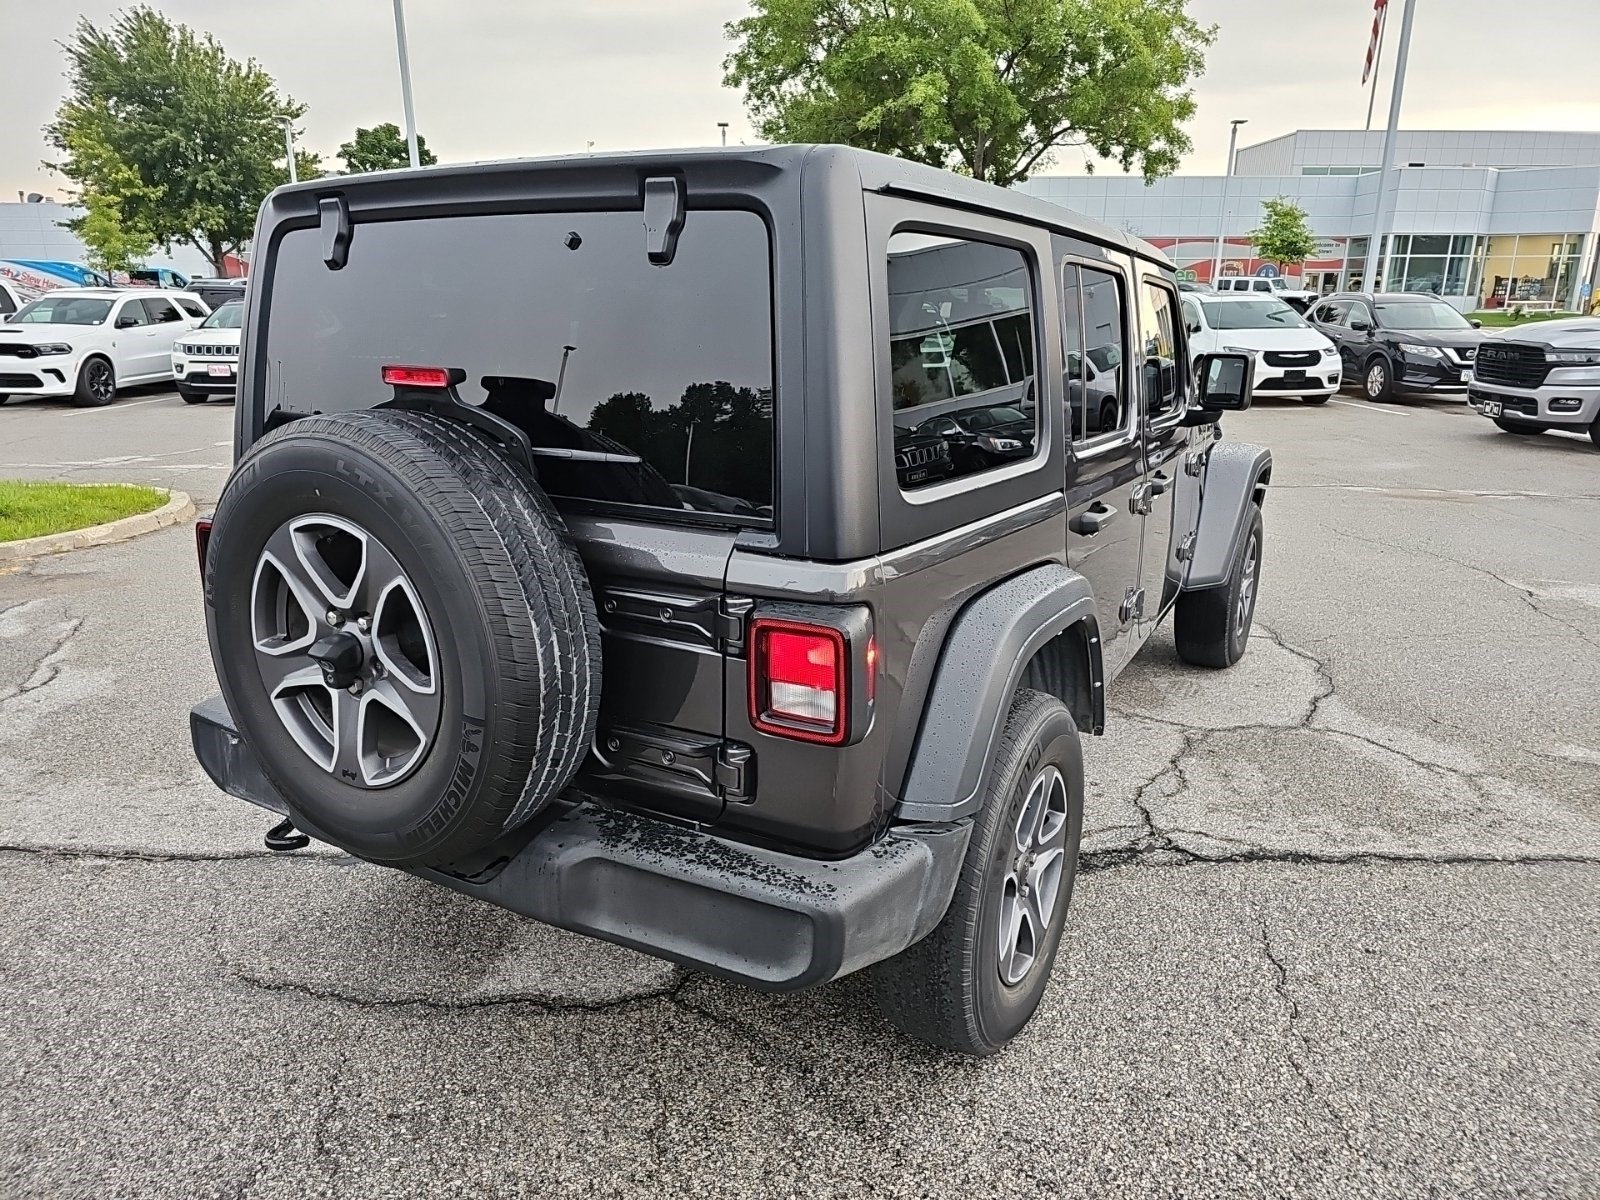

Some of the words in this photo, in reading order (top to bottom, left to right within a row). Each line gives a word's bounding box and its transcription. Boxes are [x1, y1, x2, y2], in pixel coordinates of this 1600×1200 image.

[21, 271, 42, 285] Stew
[1486, 349, 1520, 361] RAM
[335, 459, 393, 506] LTX
[405, 757, 476, 842] MICHELIN
